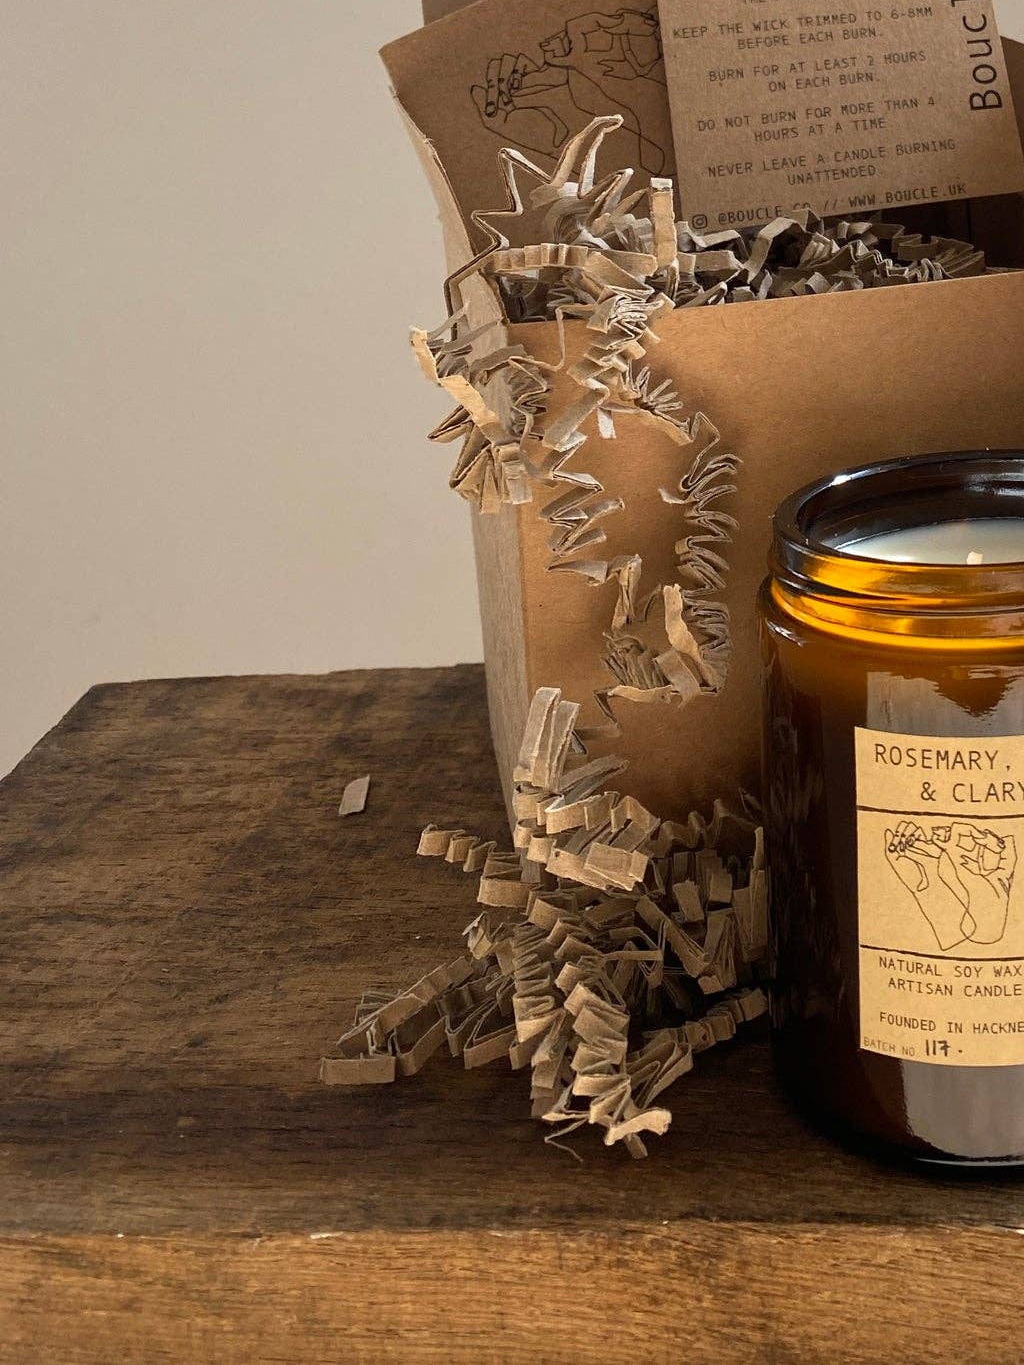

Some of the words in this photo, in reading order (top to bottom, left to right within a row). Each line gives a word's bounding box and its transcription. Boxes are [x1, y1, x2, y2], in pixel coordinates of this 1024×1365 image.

[673, 26, 707, 39] KEEP
[719, 23, 743, 35] THE
[753, 19, 789, 32] WICK
[796, 13, 857, 27] TRIMMED
[865, 10, 881, 22] TO
[890, 6, 933, 20] 6-8MM
[737, 36, 790, 50] BEFORE
[800, 32, 834, 45] EACH
[709, 68, 744, 82] BURN
[754, 65, 779, 77] FOR
[789, 62, 806, 73] AT
[815, 57, 857, 71] LEAST
[867, 56, 875, 66] 2
[884, 51, 927, 64] HOURS
[768, 81, 786, 92] ON
[796, 77, 830, 90] EACH
[697, 120, 715, 132] DO
[726, 115, 751, 128] NOT
[761, 112, 797, 125] BURN
[806, 107, 832, 119] FOR
[841, 102, 875, 115] MORE
[884, 98, 919, 111] THAN
[927, 96, 936, 107] 4
[755, 128, 799, 142] HOURS
[808, 125, 824, 137] AT
[835, 122, 843, 133] A
[708, 161, 753, 178] NEVER
[763, 156, 807, 171] LEAVE
[817, 153, 826, 164] A
[834, 147, 886, 163] CANDLE
[896, 138, 956, 155] BURNING
[875, 744, 1011, 771] ROSEMARY,
[920, 782, 937, 802] &
[879, 957, 942, 977] NATURAL
[954, 966, 982, 978] SOY
[993, 965, 1023, 978] WAX
[888, 978, 953, 996] ARTISAN
[964, 984, 1022, 997] CANDLE
[879, 1012, 936, 1031] FOUNDED
[947, 1022, 962, 1034] IN
[864, 1036, 896, 1053] BATCH
[901, 1046, 916, 1057] NO
